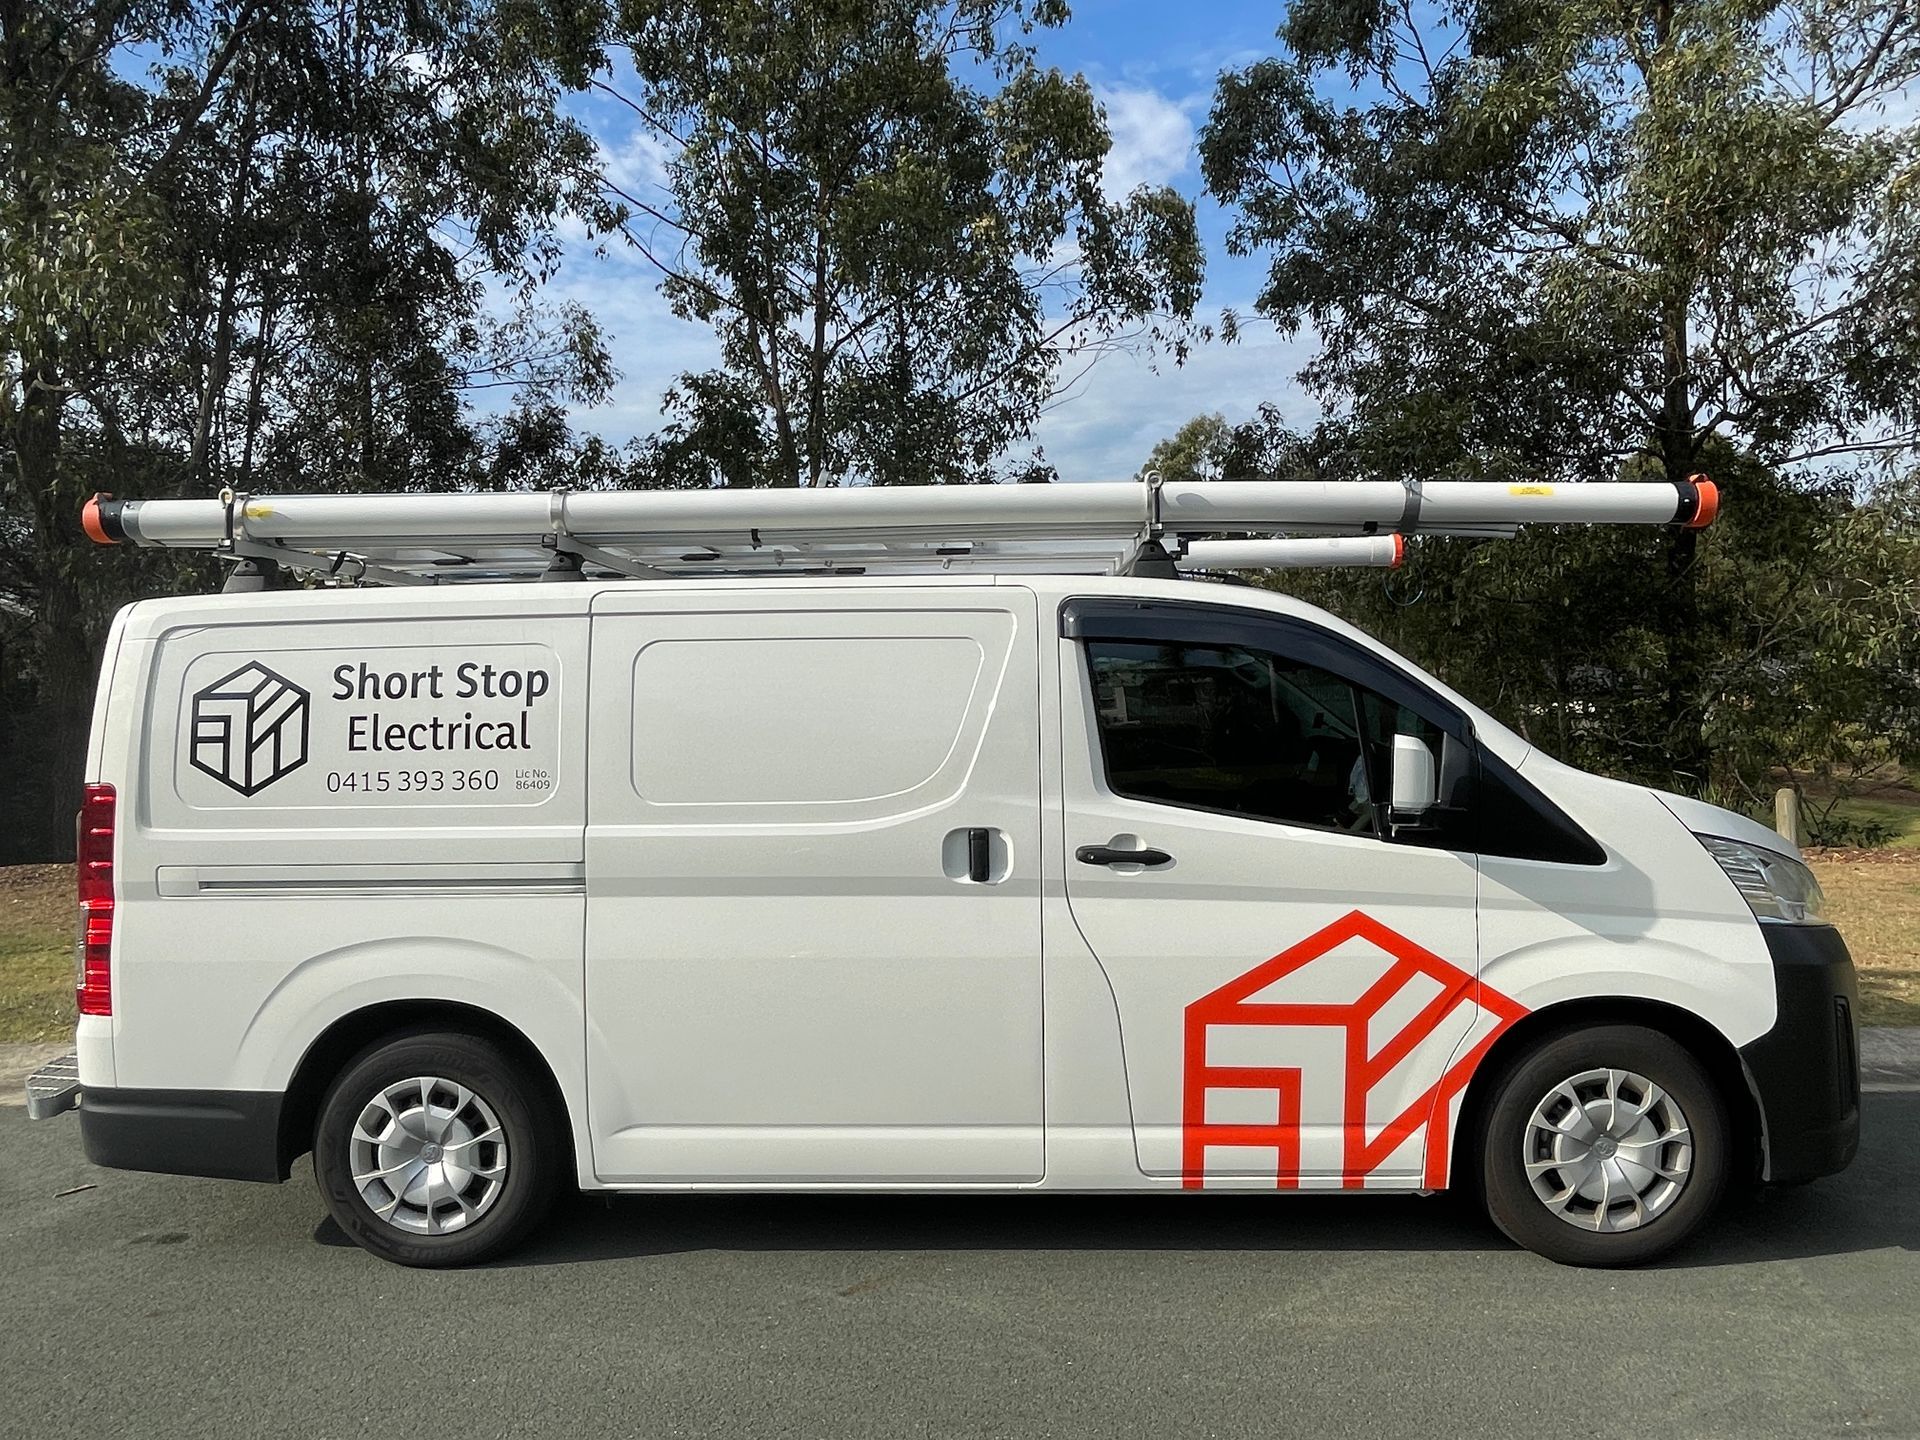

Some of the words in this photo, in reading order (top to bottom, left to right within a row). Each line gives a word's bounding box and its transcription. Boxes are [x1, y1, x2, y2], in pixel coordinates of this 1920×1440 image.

[332, 662, 443, 701] Short
[456, 662, 549, 707] Stop
[348, 711, 531, 751] Electrical
[326, 771, 391, 793] 0415
[397, 770, 445, 792] 393
[451, 769, 499, 791] 360
[515, 769, 530, 779] Lic
[532, 769, 551, 779] No.
[515, 779, 551, 791] 86409
